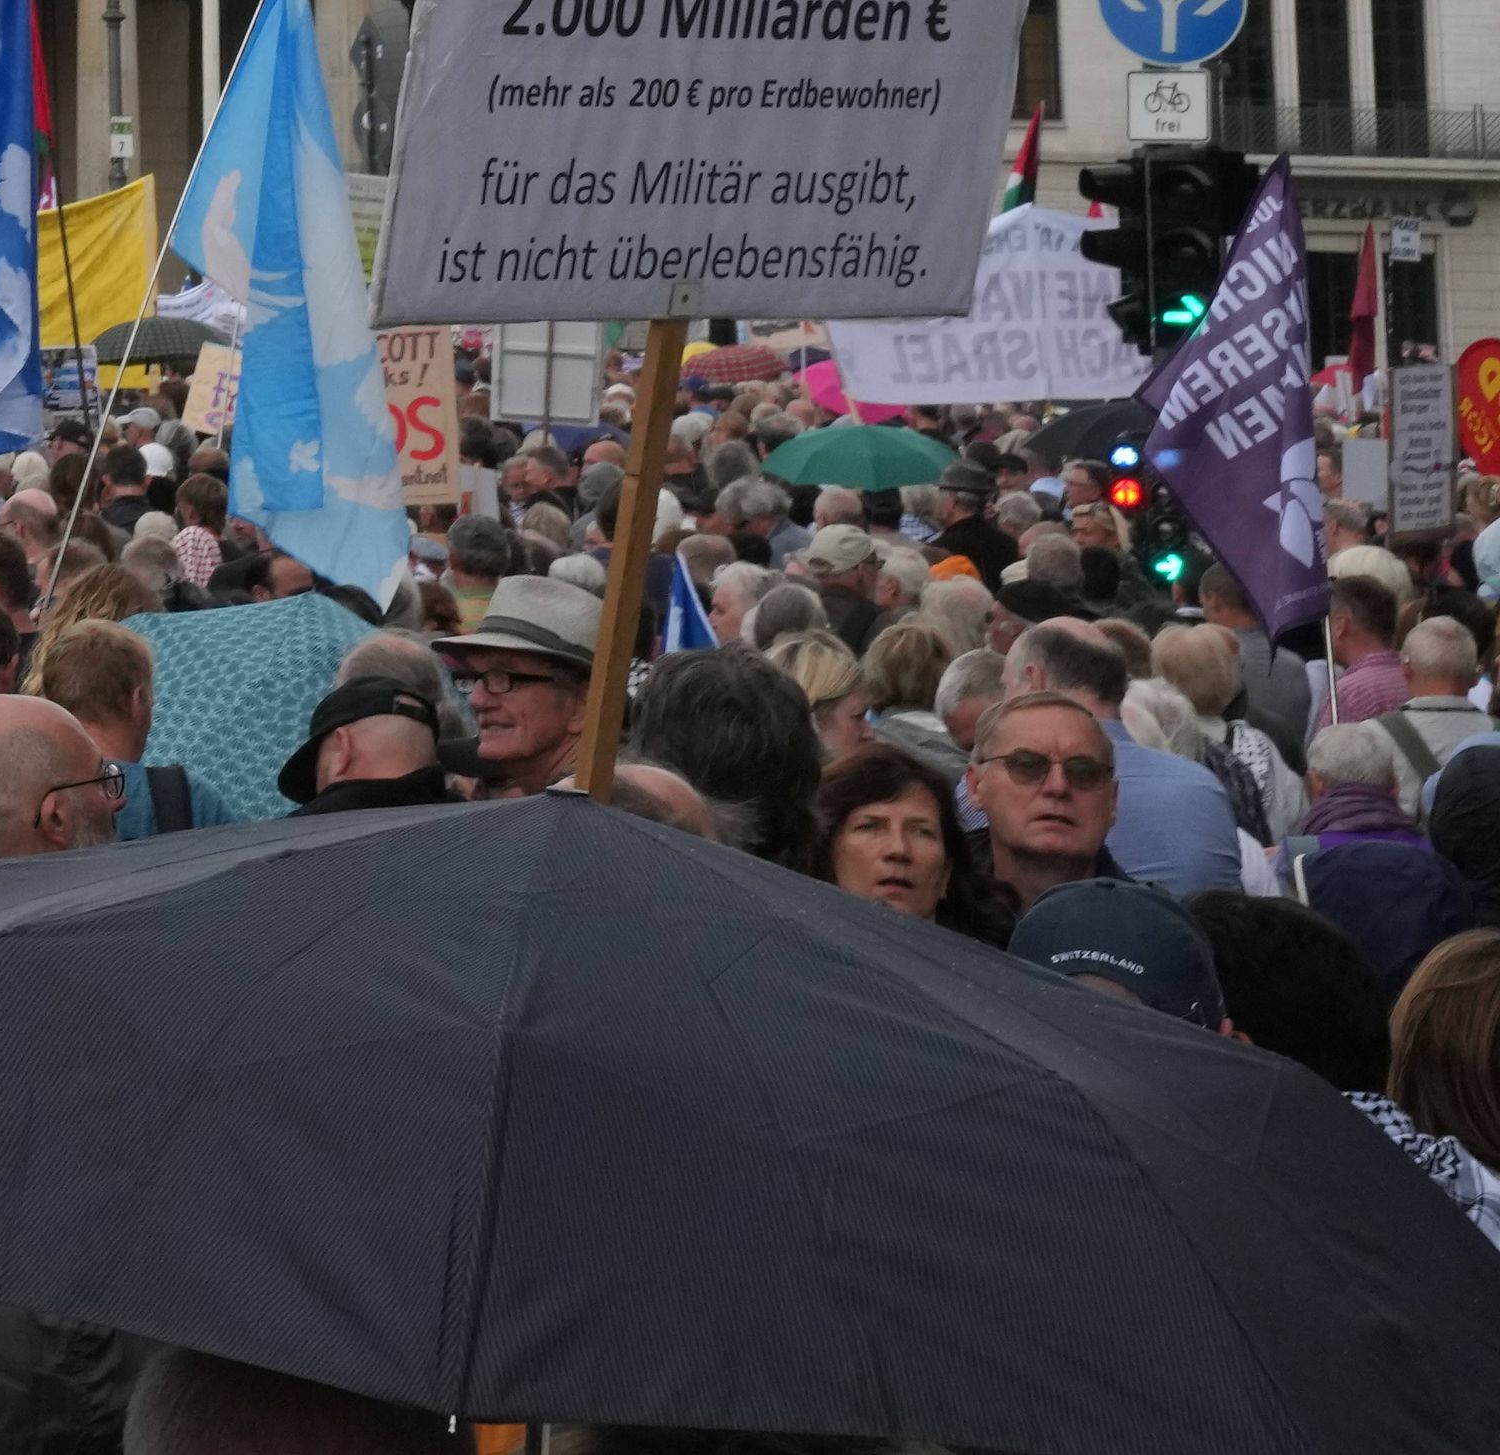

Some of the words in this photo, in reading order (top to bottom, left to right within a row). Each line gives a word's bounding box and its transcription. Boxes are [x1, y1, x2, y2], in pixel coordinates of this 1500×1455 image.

[488, 74, 572, 113] (mehr
[578, 76, 616, 108] als
[629, 76, 681, 108] 200
[686, 77, 703, 109] €
[708, 85, 752, 115] pro
[760, 77, 942, 115] Erdbewohner)
[1155, 117, 1181, 133] frei
[118, 142, 126, 154] 7
[479, 157, 538, 206] für
[549, 158, 616, 206] das
[629, 158, 762, 206] Militär
[771, 162, 918, 215] ausgibt,
[438, 239, 485, 283] ist
[498, 236, 599, 282] nicht
[609, 237, 928, 288] überlebensfähig.
[1050, 949, 1146, 975] SWITZERLAND
